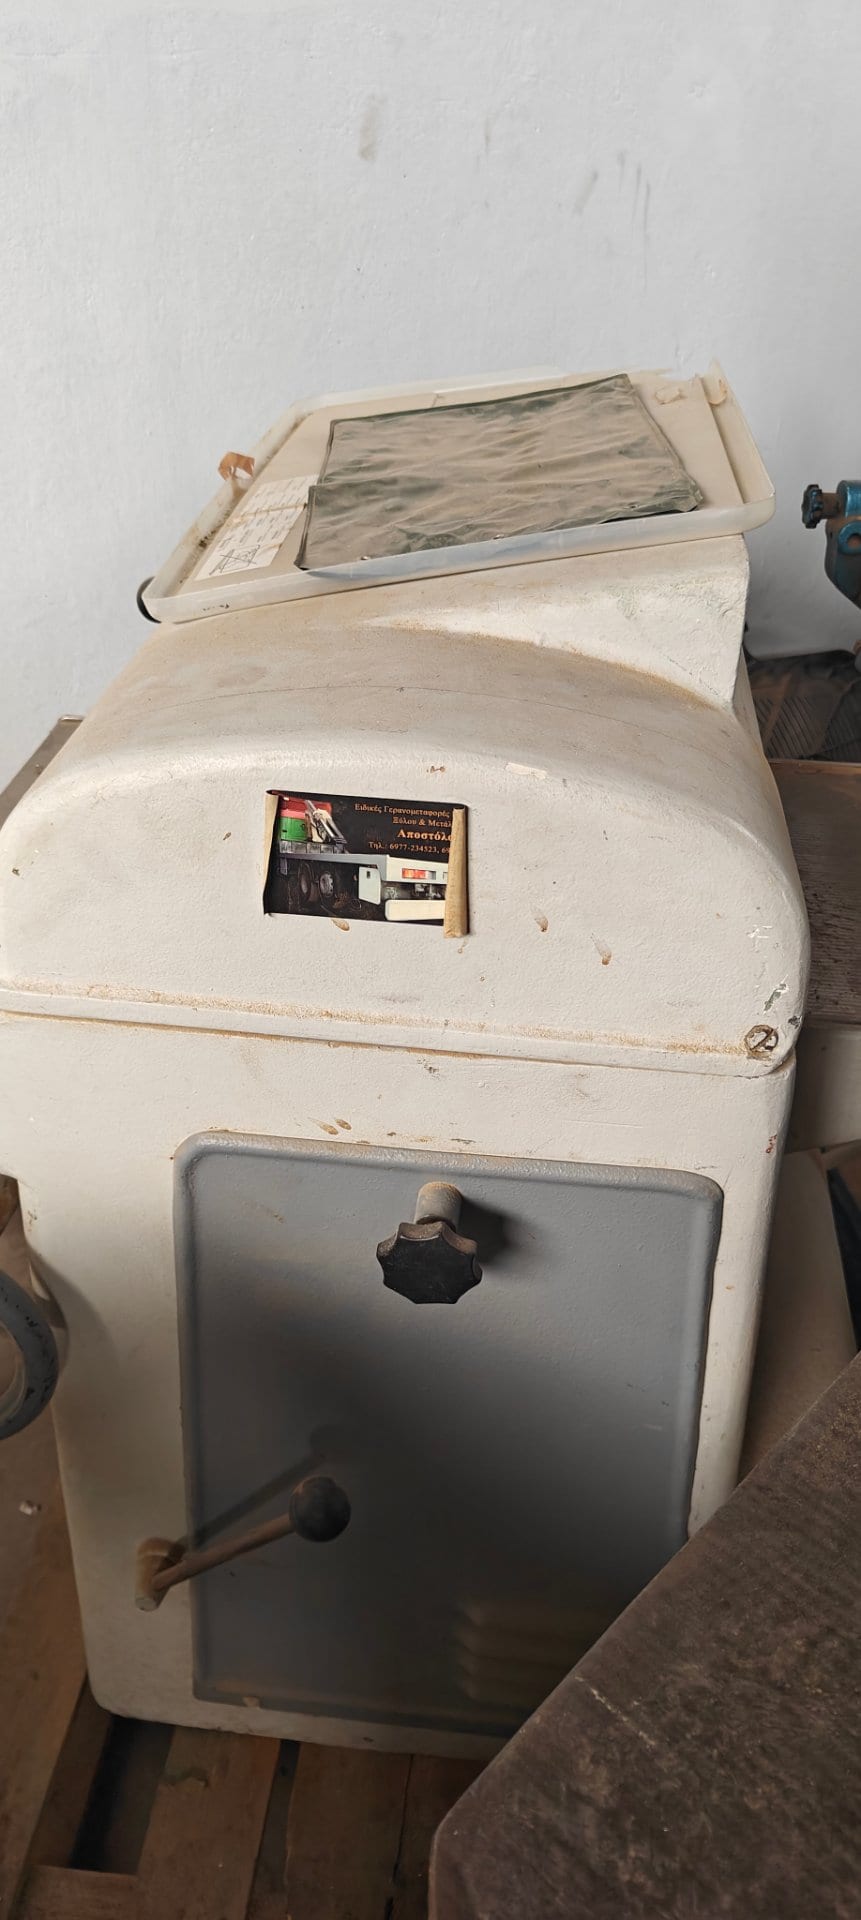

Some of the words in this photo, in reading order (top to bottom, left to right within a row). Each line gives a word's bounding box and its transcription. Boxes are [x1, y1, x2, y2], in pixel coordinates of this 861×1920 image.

[354, 803, 382, 814] Ειδικές
[384, 805, 450, 818] Γερανομεταφορές
[392, 816, 417, 826] Ξύλου
[418, 818, 426, 826] &
